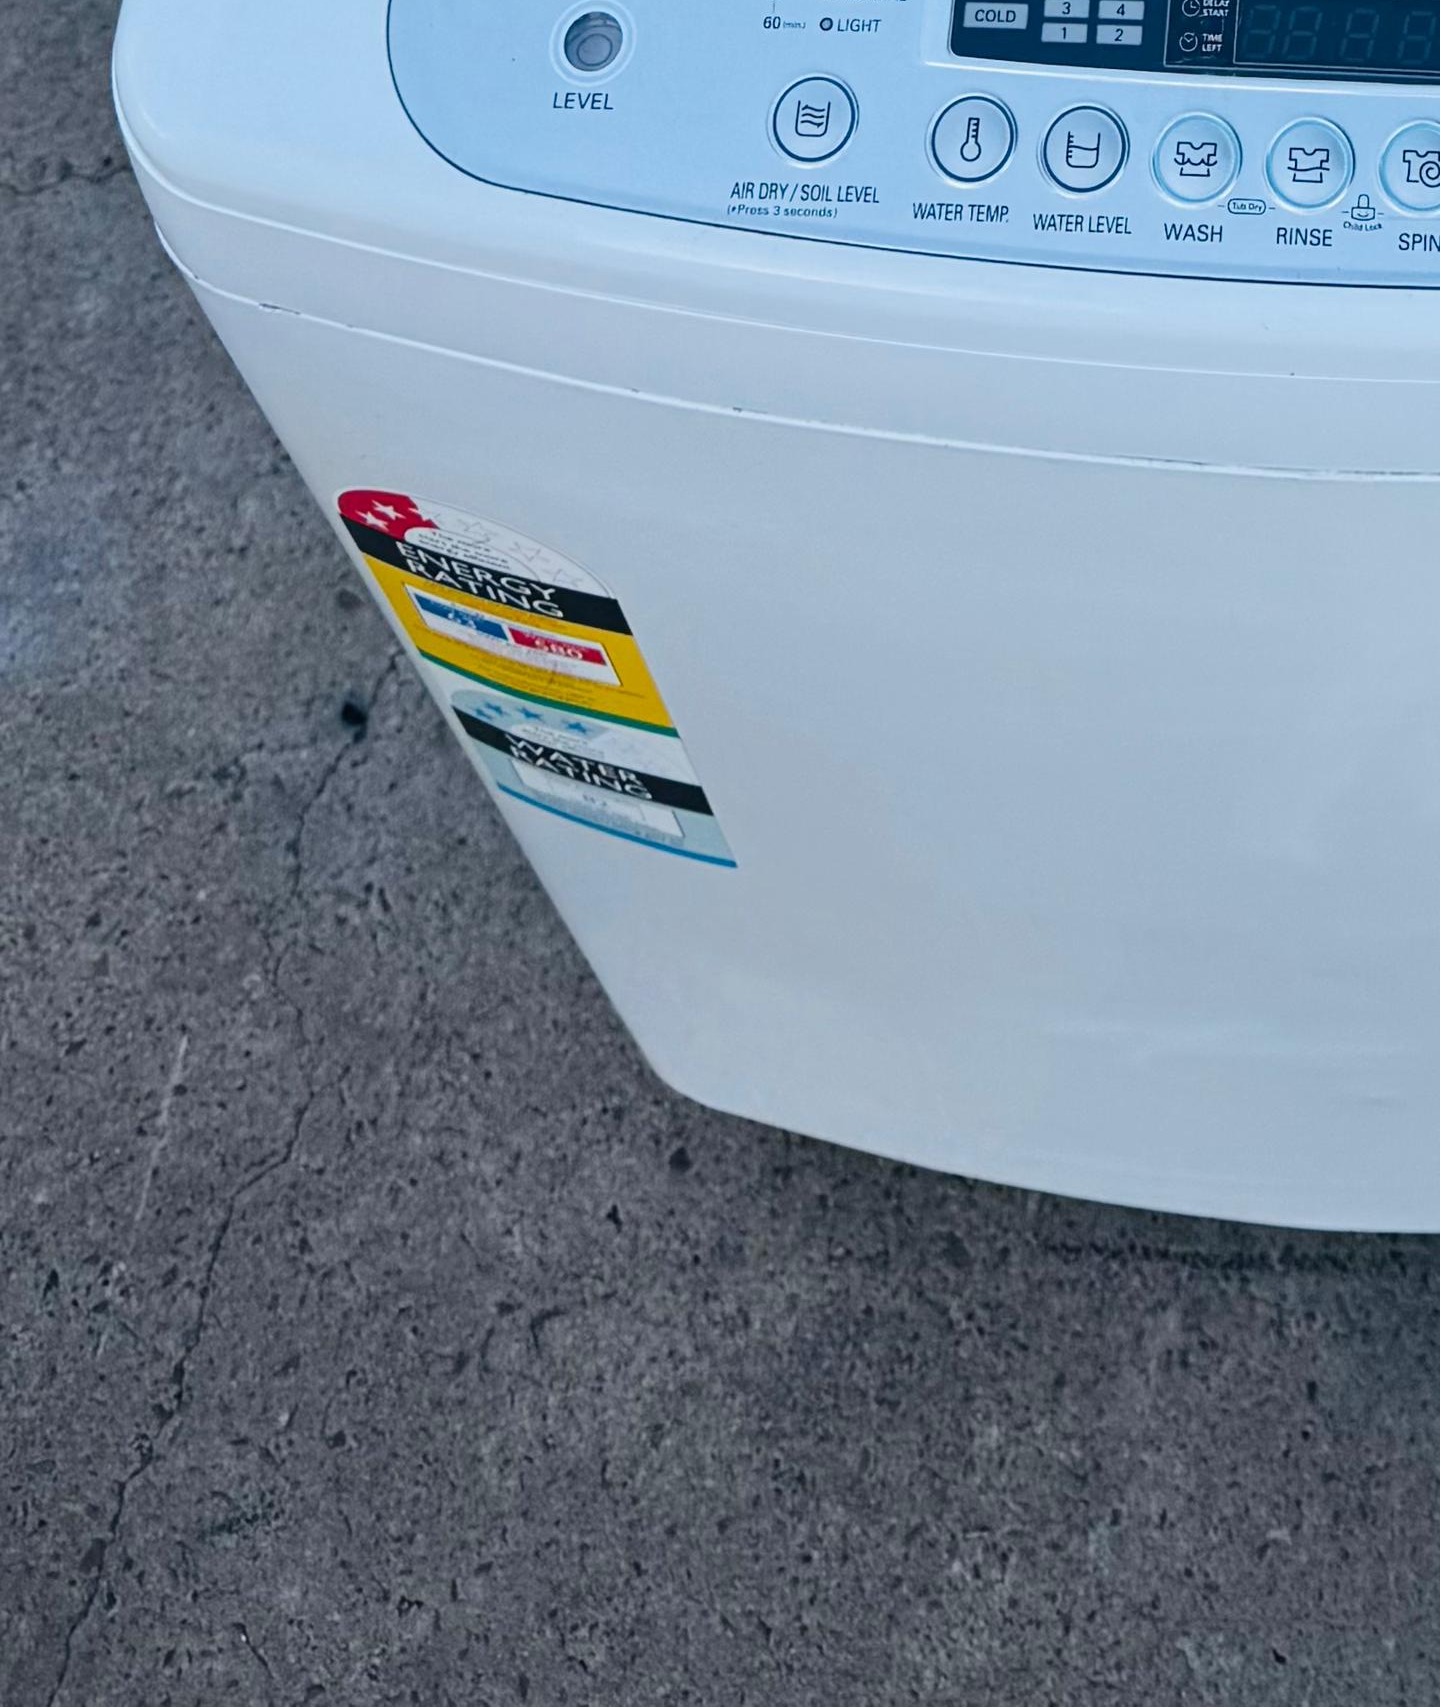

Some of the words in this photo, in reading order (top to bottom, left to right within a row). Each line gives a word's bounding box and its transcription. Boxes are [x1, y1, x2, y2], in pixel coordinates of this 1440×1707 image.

[1062, 2, 1071, 15] 3
[1116, 4, 1126, 16] 4
[1203, 8, 1229, 17] START
[763, 16, 781, 30] 60
[974, 9, 1017, 23] COLD
[837, 18, 882, 33] LIGHT
[1061, 27, 1067, 39] 1
[1114, 28, 1124, 42] 2
[1202, 33, 1223, 43] TIME
[1201, 43, 1223, 52] LEFT
[553, 92, 614, 110] LEVEL
[730, 181, 755, 199] AIR
[758, 182, 790, 200] DRY
[800, 184, 833, 202] SOIL
[837, 185, 880, 203] LEVEL
[773, 205, 781, 216] 3
[912, 203, 963, 221] WATER
[968, 204, 1010, 223] TEMP.
[1248, 203, 1263, 212] Dry
[1033, 213, 1083, 232] WATER
[1088, 215, 1132, 234] LEVEL
[1343, 221, 1364, 232] Child
[1364, 222, 1383, 232] Lock
[1164, 223, 1223, 242] WASH
[1276, 227, 1333, 247] RINSE
[396, 541, 556, 601] ENERGY
[406, 559, 564, 618] RATING
[505, 734, 643, 786] WATER
[510, 745, 653, 799] RATING
